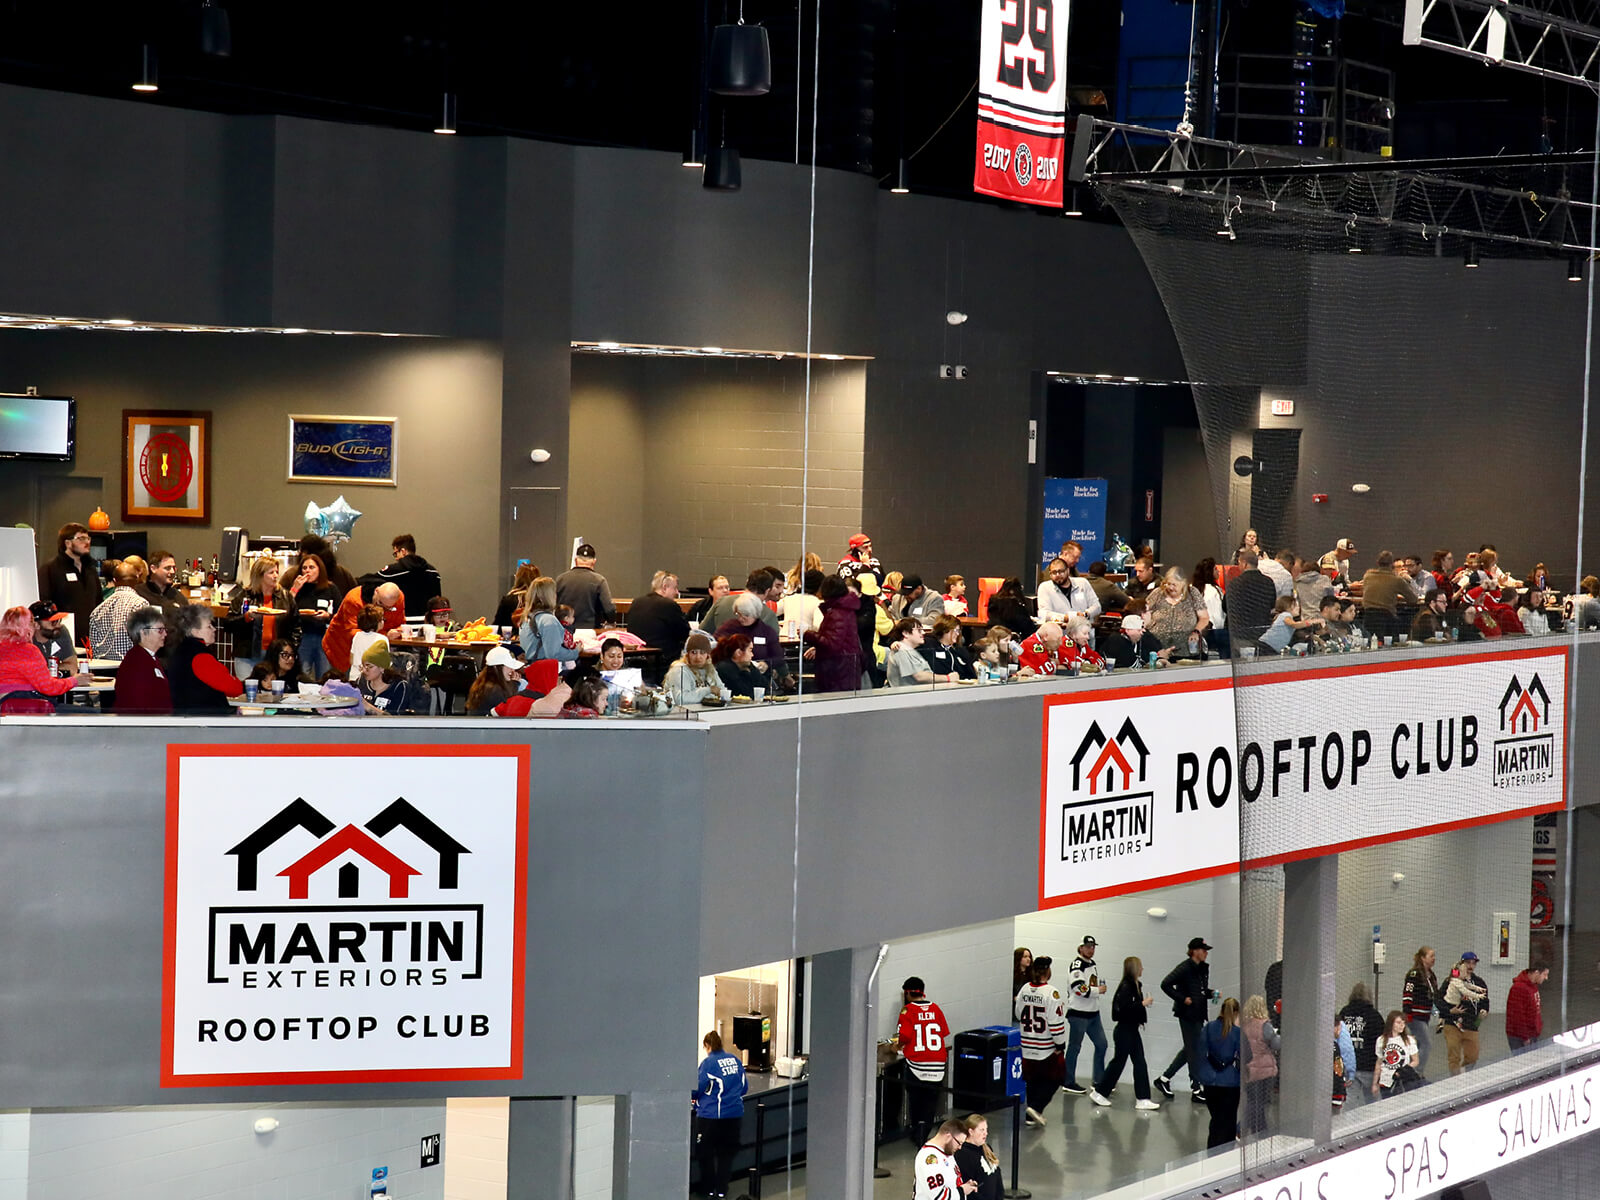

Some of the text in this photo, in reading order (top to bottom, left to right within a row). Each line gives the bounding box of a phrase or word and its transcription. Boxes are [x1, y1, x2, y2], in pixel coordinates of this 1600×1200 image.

[997, 0, 1056, 93] 29
[296, 443, 386, 455] BUD LIGHT
[1176, 716, 1479, 813] ROOFTOP CLUB
[1498, 743, 1550, 775] MARTIN
[1500, 772, 1546, 789] EXTERIORS
[1069, 805, 1147, 847] MARTIN
[1072, 839, 1142, 863] EXTERIORS
[229, 921, 463, 964] MARTIN
[243, 968, 447, 989] EXTERIORS
[199, 1015, 490, 1043] ROOFTOP CLUB
[1021, 1005, 1047, 1034] 45
[914, 1023, 942, 1052] 16
[721, 1065, 739, 1076] STAFF
[1497, 1077, 1592, 1157] SAUNAS
[1385, 1128, 1450, 1200] SPAS
[926, 1173, 944, 1190] 28
